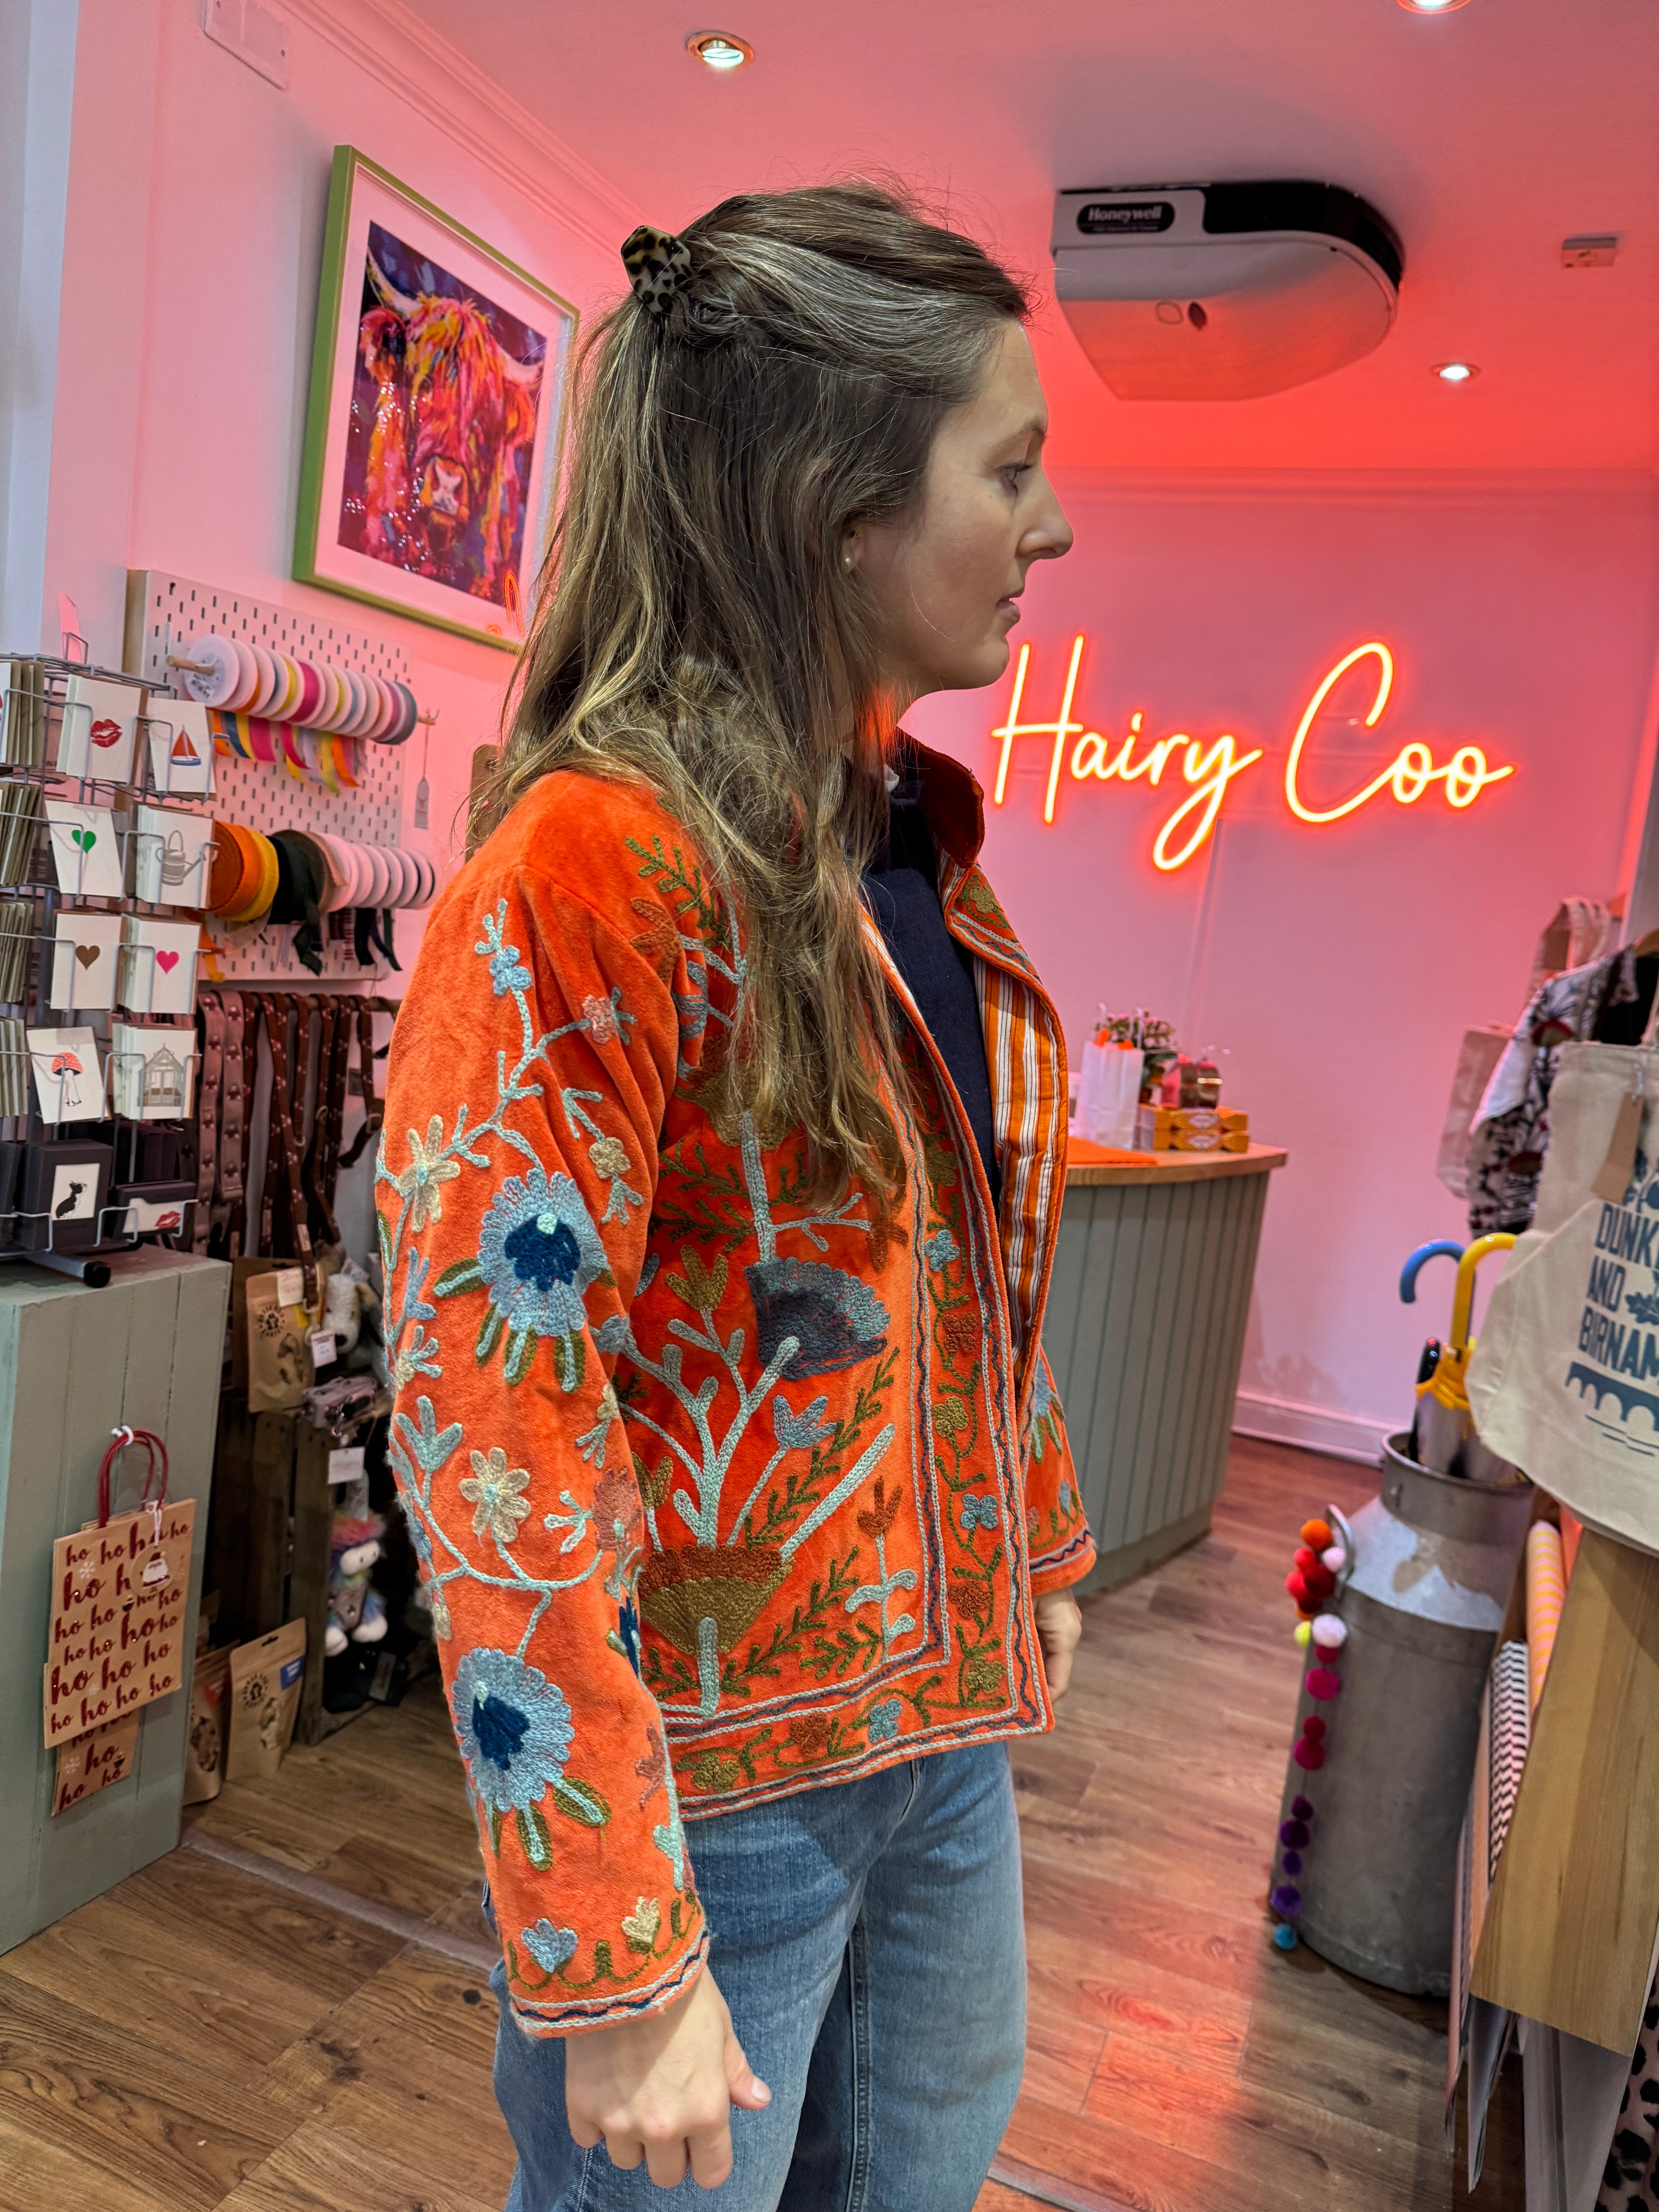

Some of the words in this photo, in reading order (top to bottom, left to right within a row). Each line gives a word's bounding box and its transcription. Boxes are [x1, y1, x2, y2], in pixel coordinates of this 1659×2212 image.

[1088, 205, 1162, 223] Honeywell
[992, 634, 1262, 870] Hairy
[1286, 642, 1514, 822] Coo
[1595, 1202, 1659, 1269] DUNK
[1587, 1255, 1626, 1312] AND
[66, 1544, 90, 1567] ho
[100, 1540, 127, 1564] ho
[171, 1521, 189, 1539] ho
[55, 1617, 85, 1643] ho
[90, 1604, 118, 1630] ho
[159, 1589, 183, 1610] ho
[64, 1571, 106, 1611] ho
[64, 1645, 88, 1665] ho
[89, 1636, 117, 1661] ho
[121, 1613, 159, 1650] ho
[159, 1614, 181, 1632] ho
[51, 1665, 94, 1705] ho
[102, 1656, 136, 1690] ho
[143, 1640, 172, 1667] ho
[51, 1713, 73, 1734] ho
[81, 1697, 112, 1726] ho
[116, 1685, 142, 1709] ho
[149, 1673, 175, 1696] ho
[85, 1743, 119, 1775] ho
[59, 1783, 87, 1810] ho
[102, 1767, 123, 1786] ho
